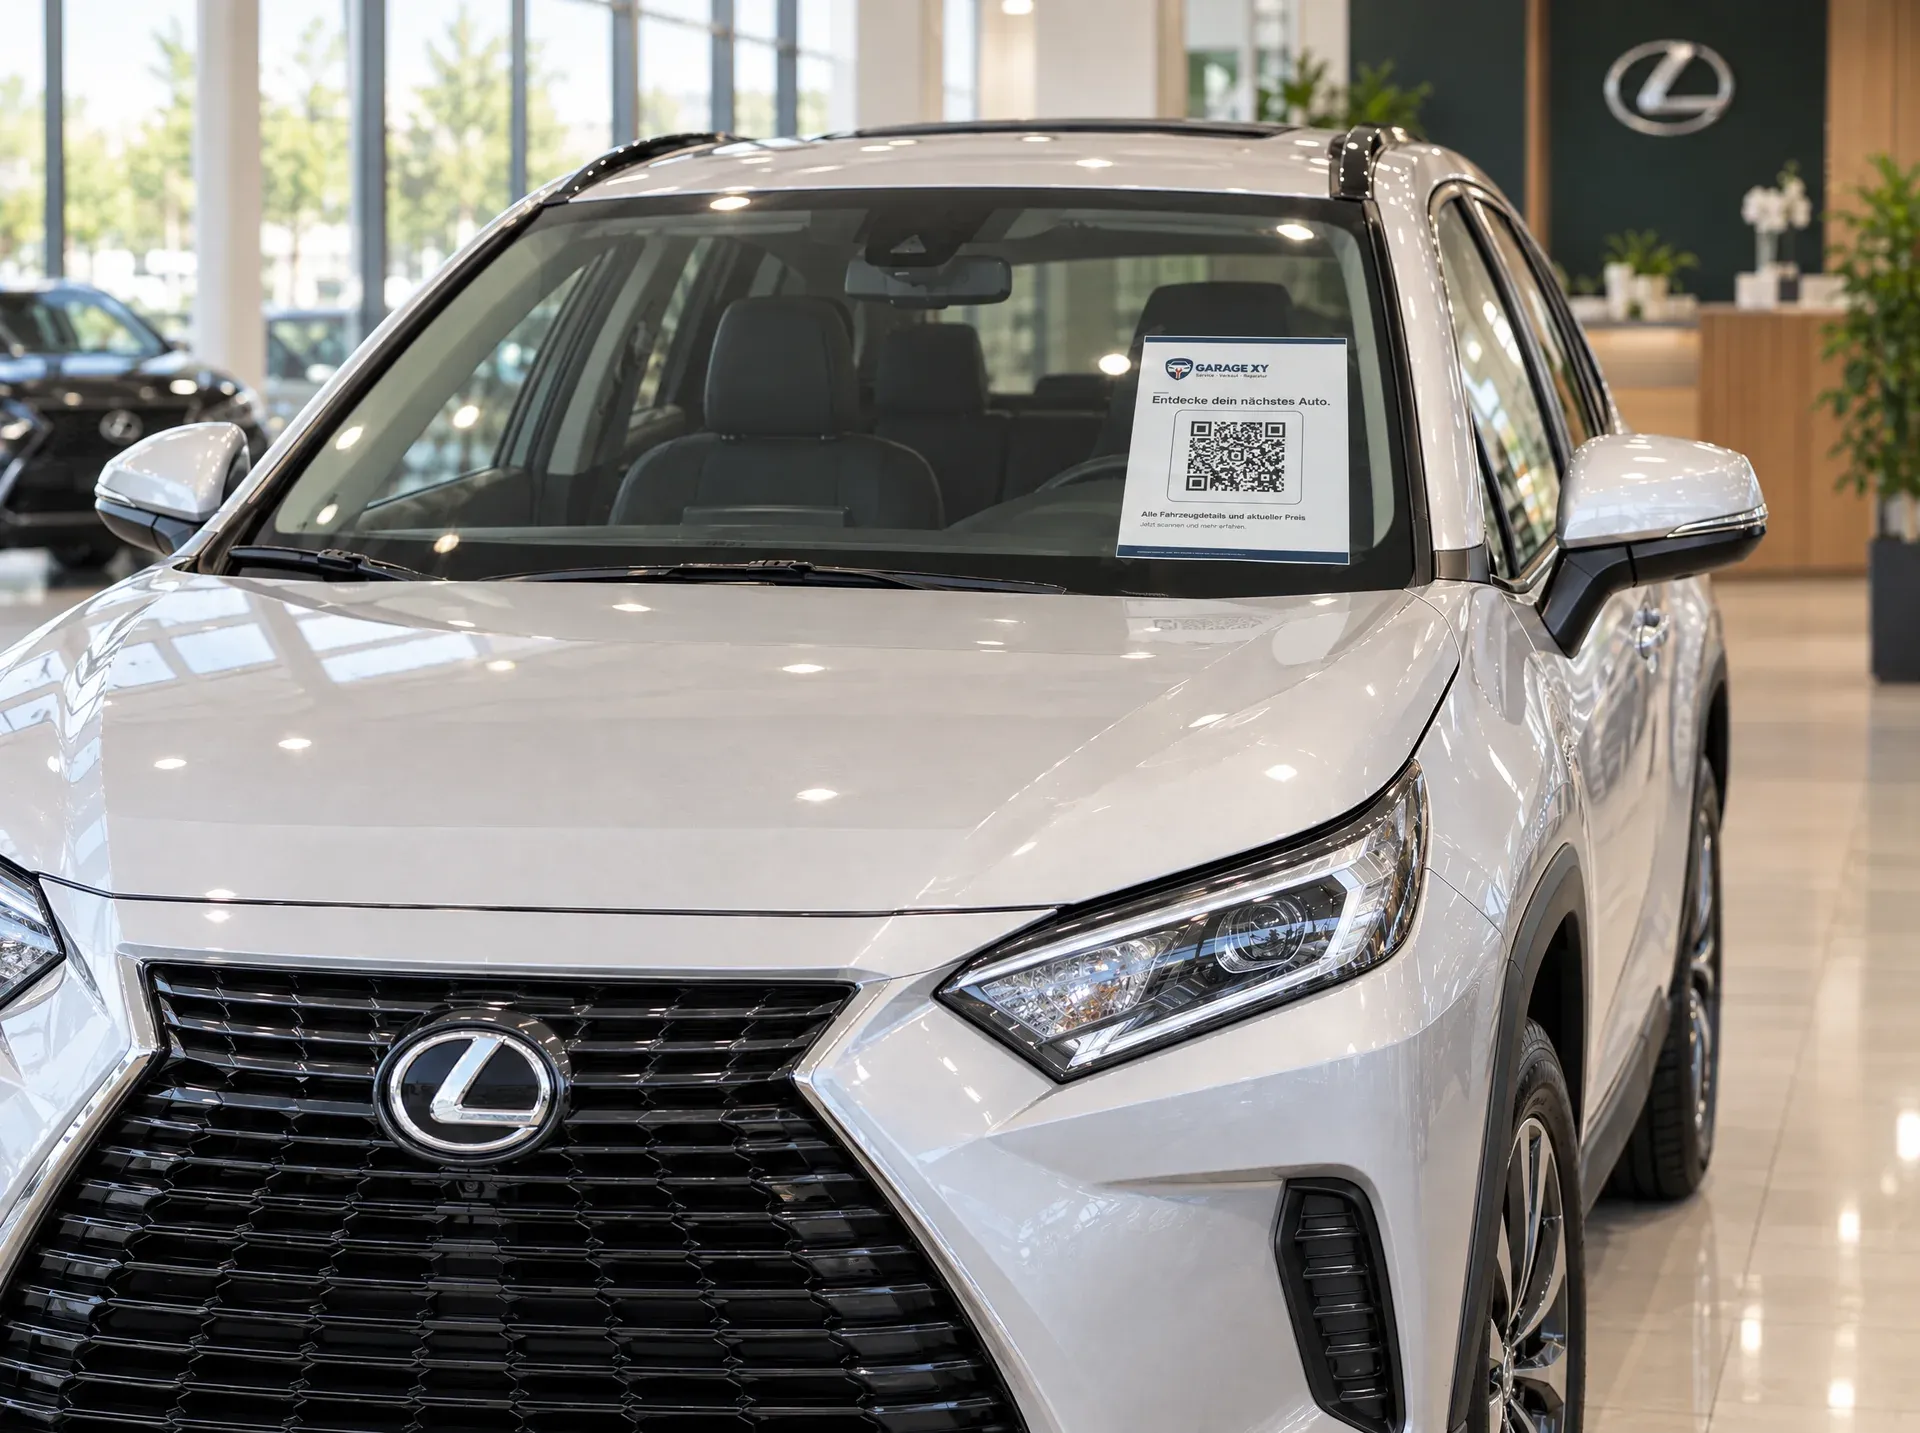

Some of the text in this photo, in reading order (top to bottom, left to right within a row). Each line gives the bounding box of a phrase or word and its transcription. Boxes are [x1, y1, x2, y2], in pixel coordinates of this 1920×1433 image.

[1195, 363, 1269, 373] GARAGE XY
[1152, 395, 1331, 406] Entdecke dein nächstes Auto.
[1159, 511, 1226, 520] Fahrzeugdetails
